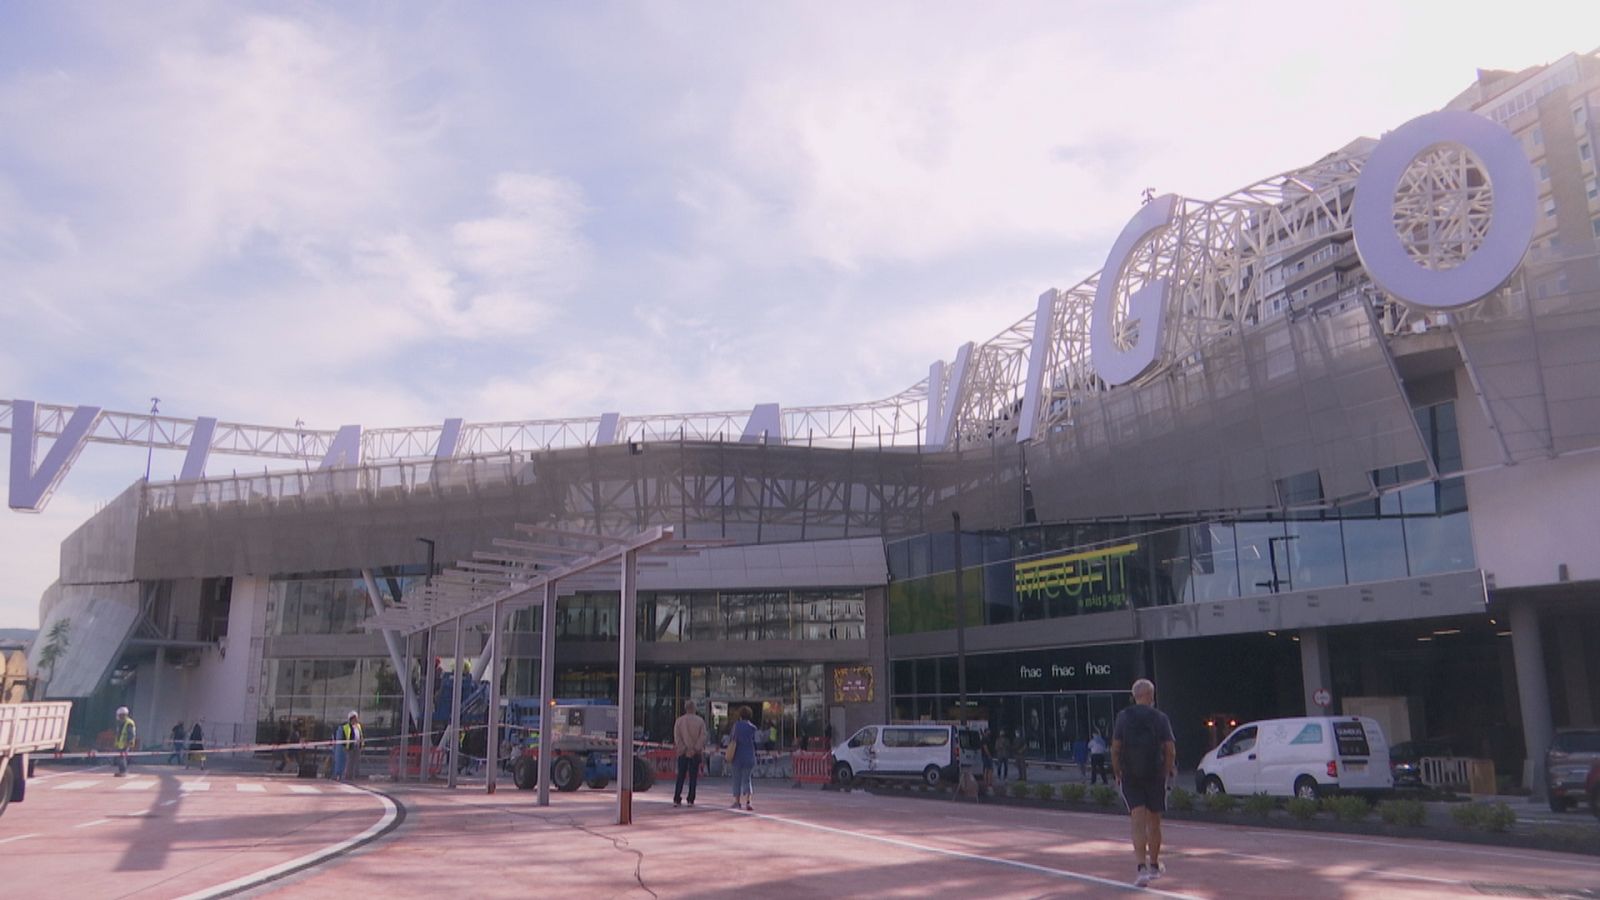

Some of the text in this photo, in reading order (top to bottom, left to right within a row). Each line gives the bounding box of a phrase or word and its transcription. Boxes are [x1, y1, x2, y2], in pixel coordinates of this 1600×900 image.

[8, 110, 1537, 509] VIA VIGO
[1020, 661, 1111, 678] fnac fnac fnac
